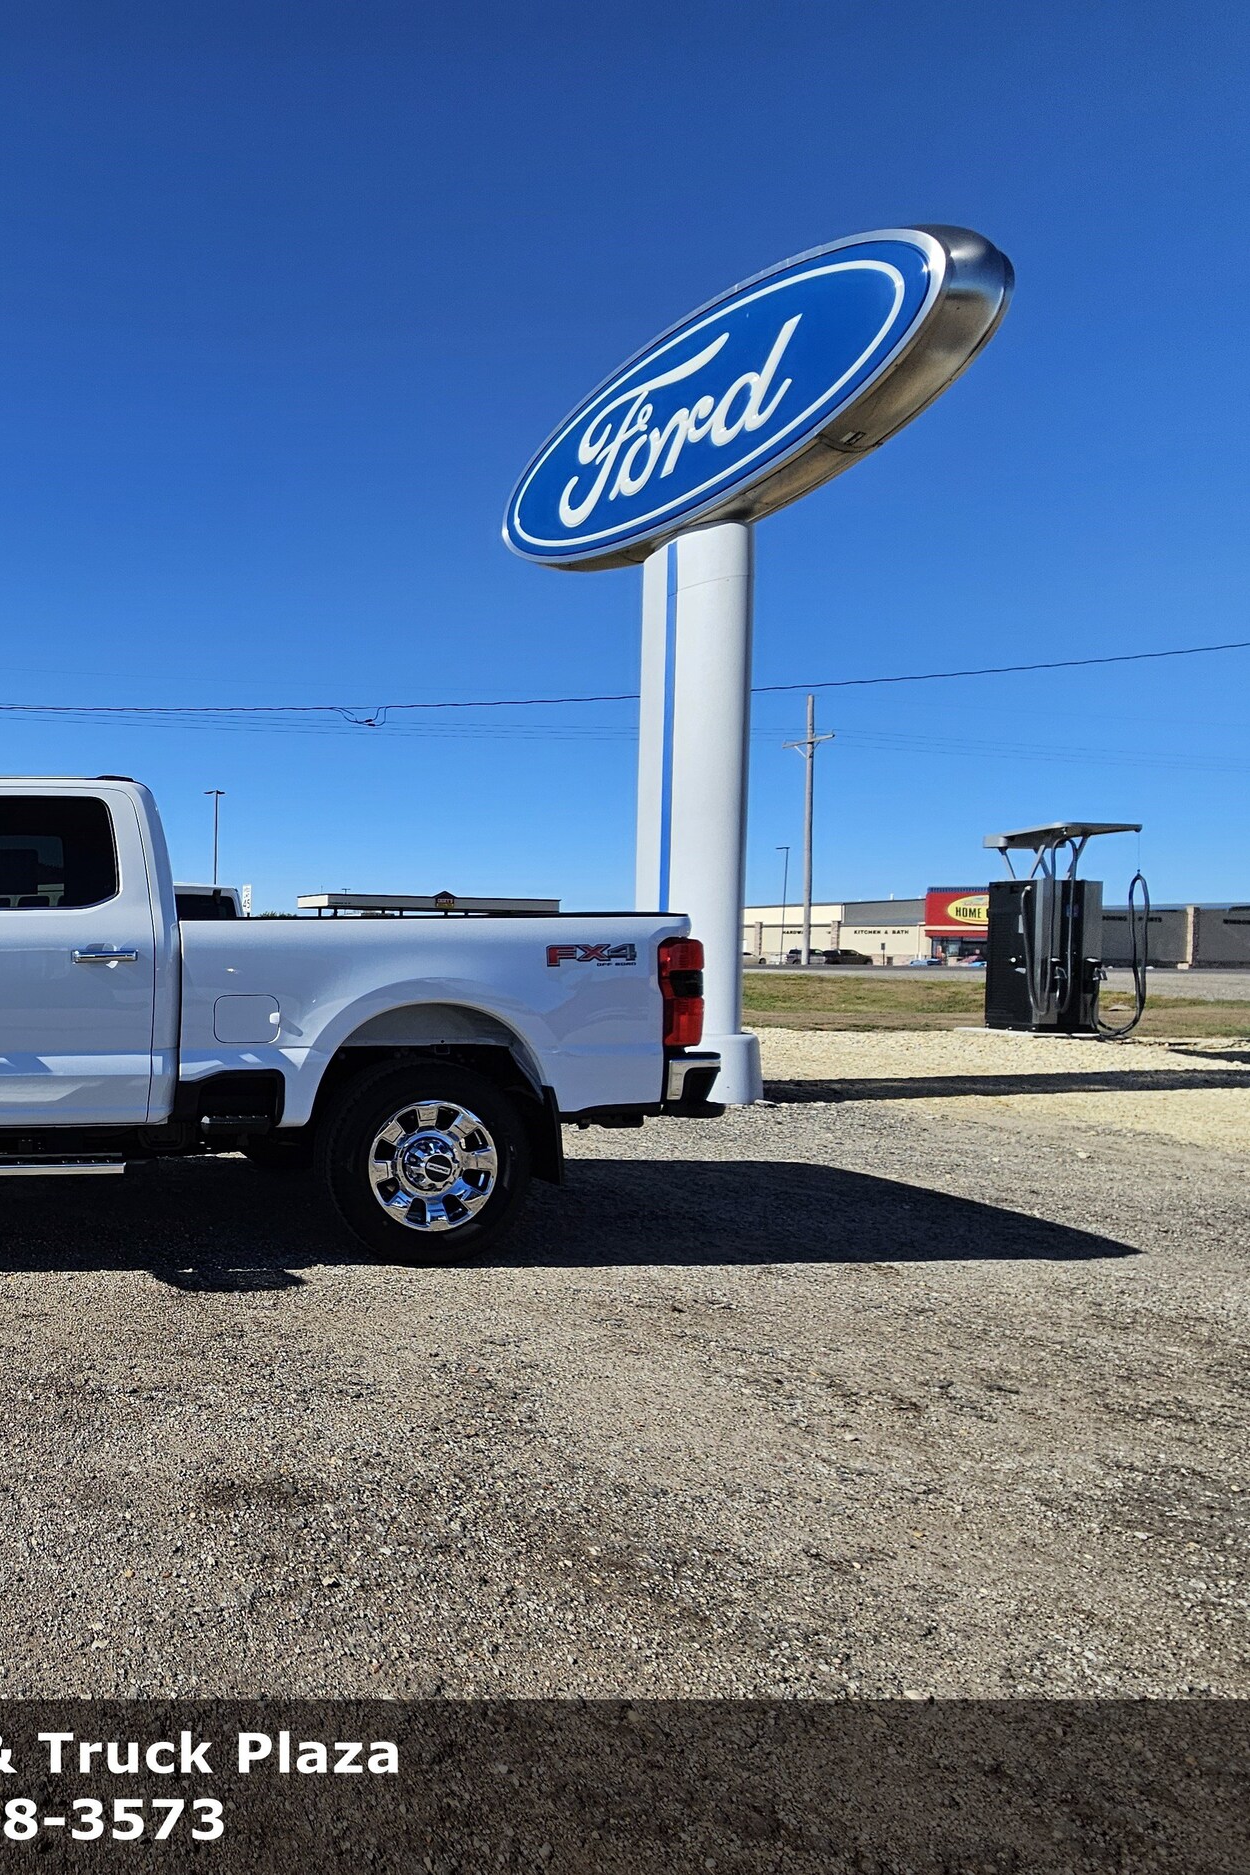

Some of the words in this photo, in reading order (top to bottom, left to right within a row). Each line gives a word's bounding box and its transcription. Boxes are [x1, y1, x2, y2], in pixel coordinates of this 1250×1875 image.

[557, 312, 803, 528] Ford
[955, 906, 982, 919] HOME
[546, 943, 637, 967] FX4
